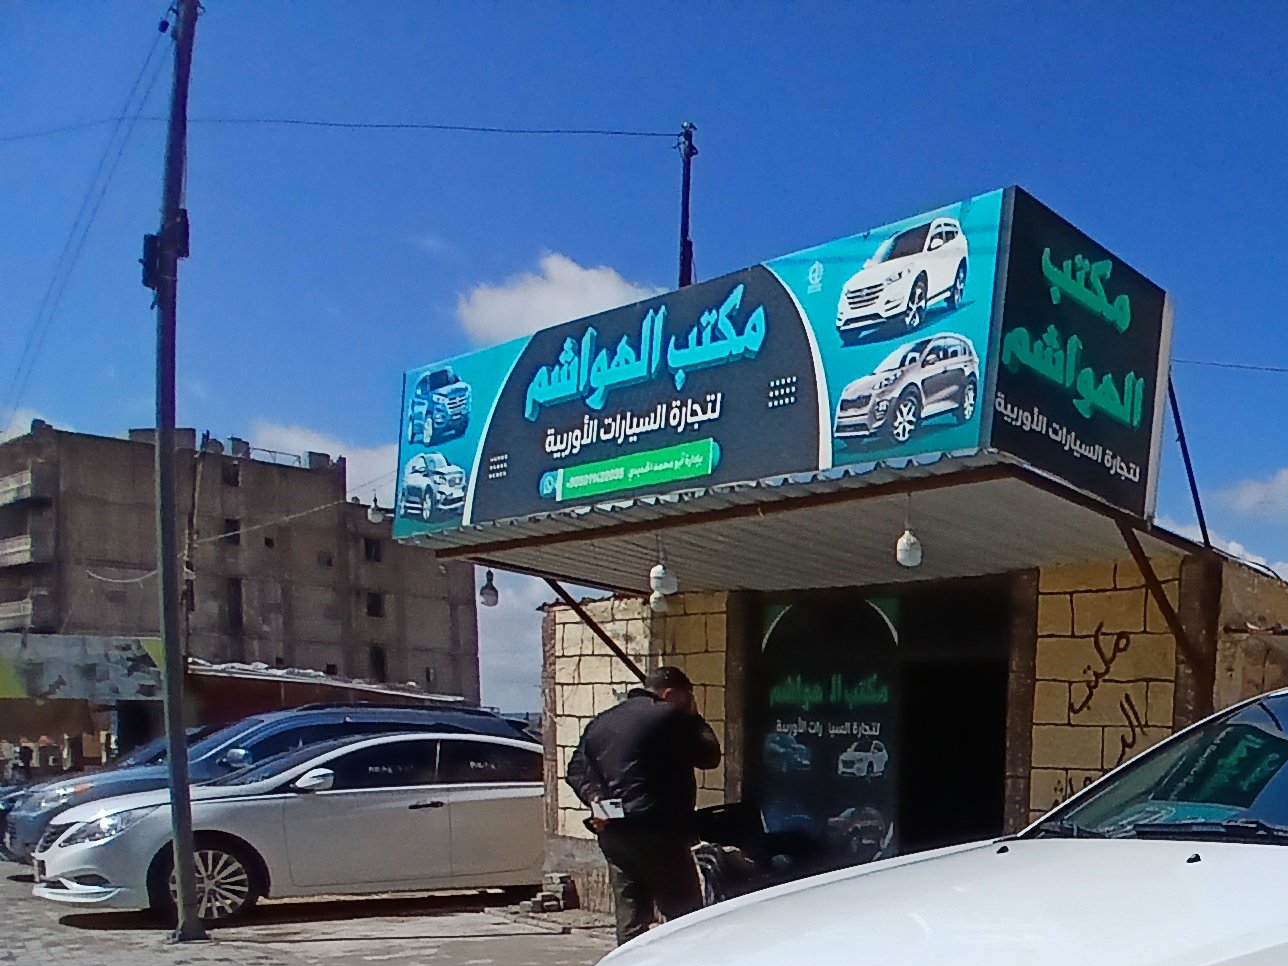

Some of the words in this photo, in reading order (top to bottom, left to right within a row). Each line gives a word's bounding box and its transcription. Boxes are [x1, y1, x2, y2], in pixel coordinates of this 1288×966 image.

[1042, 248, 1131, 334] مكتب
[667, 283, 767, 391] مكتب
[525, 304, 668, 420] الهواشم
[1002, 325, 1144, 429] الهواشم
[600, 404, 667, 444] السيارات
[669, 393, 722, 433] لتجارة
[995, 392, 1047, 435] الأوربية
[545, 414, 598, 459] الأوربية
[1049, 422, 1102, 463] السيارات
[1104, 449, 1140, 483] لتجارة
[1070, 621, 1131, 714] مكتب
[852, 721, 880, 738] لتجارة
